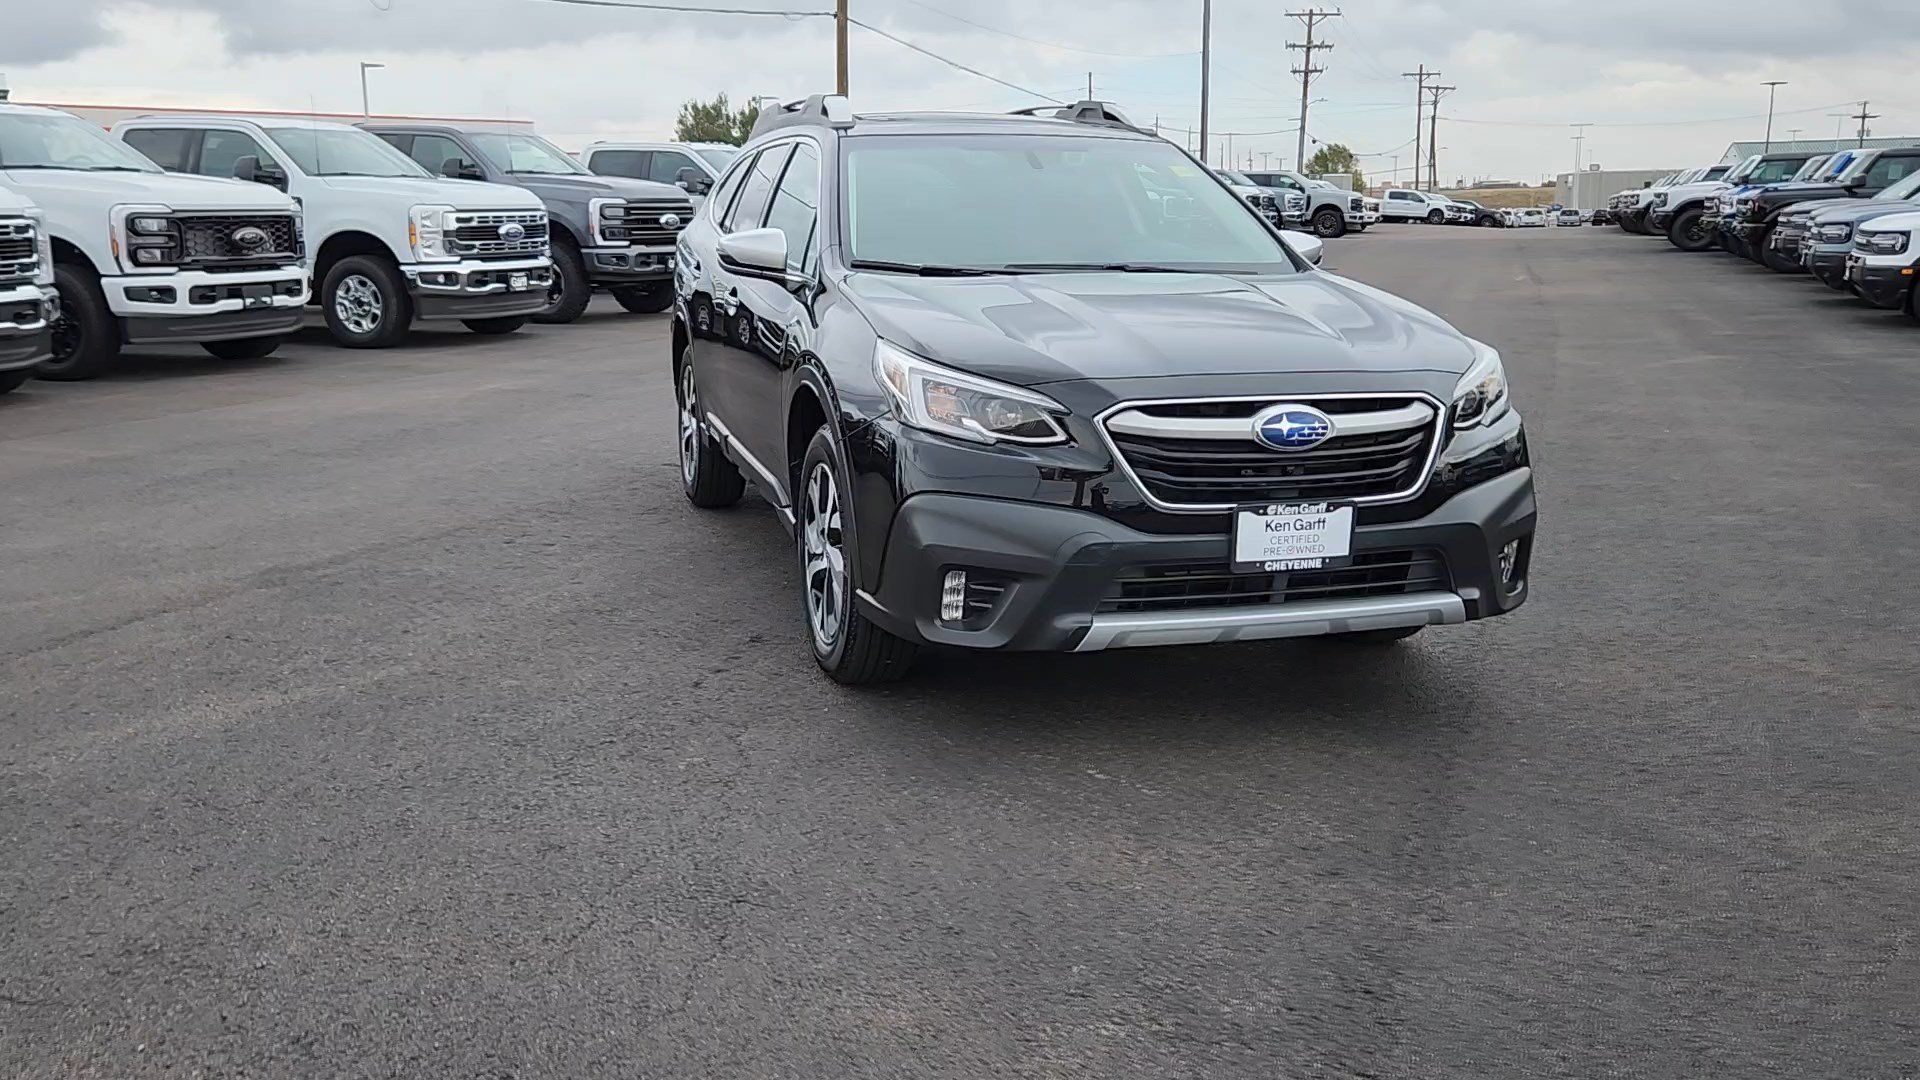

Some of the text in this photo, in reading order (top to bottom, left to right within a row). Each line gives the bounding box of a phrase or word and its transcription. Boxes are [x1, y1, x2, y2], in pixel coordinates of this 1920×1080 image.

[1277, 504, 1298, 515] Ken
[1265, 517, 1326, 533] Ken Garff
[1270, 534, 1320, 545] CERTIFIED
[1264, 558, 1323, 572] CHEYENNE
